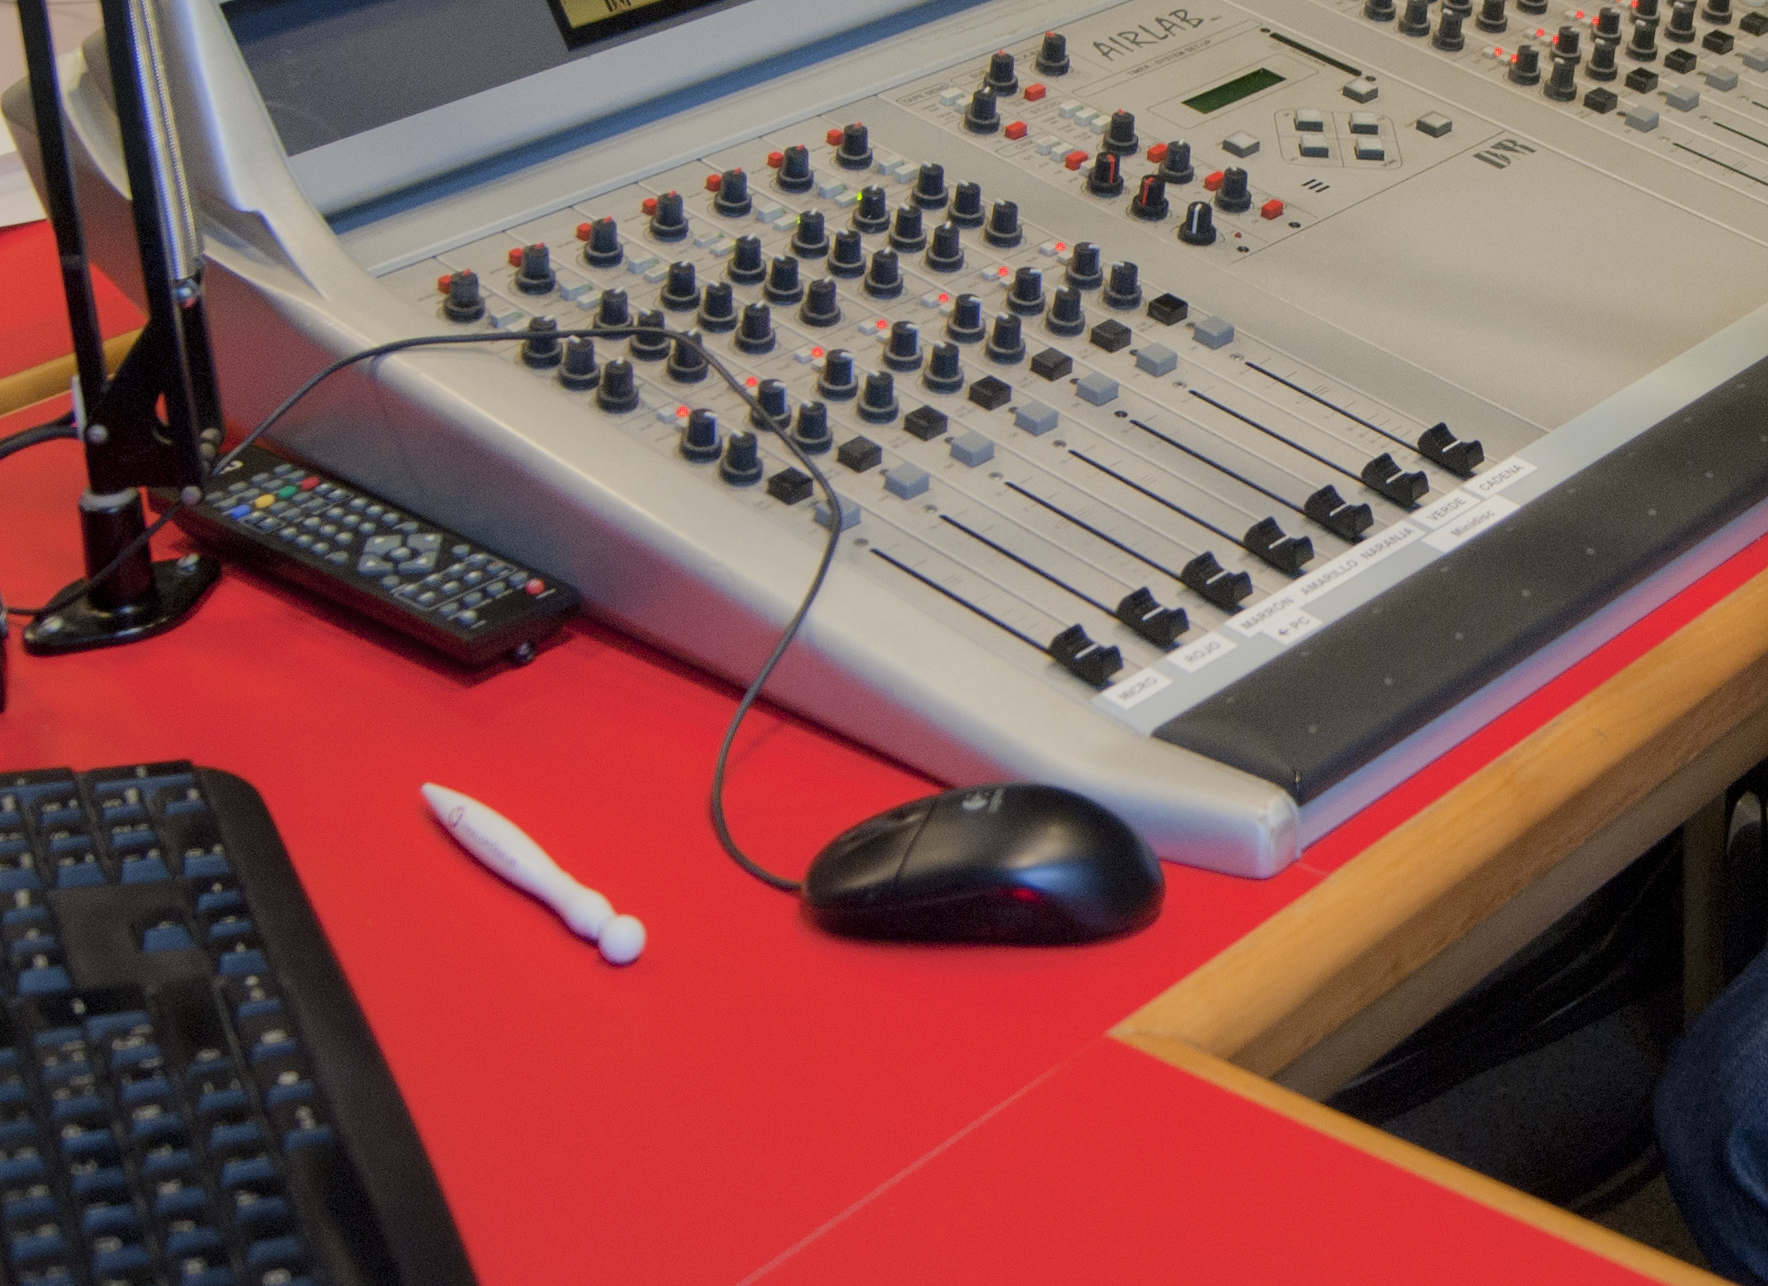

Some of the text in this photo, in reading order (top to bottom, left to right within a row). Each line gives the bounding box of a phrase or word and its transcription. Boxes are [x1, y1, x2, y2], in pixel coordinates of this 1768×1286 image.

[1092, 8, 1204, 62] AIRLAB
[1478, 463, 1525, 492] CADENA
[1426, 496, 1467, 522] VERDE
[1450, 509, 1496, 538] Minidisc
[1300, 559, 1359, 596] AMARILLO
[1359, 526, 1415, 561] NARANJA
[1291, 615, 1311, 630] PC
[1184, 640, 1221, 664] ROJO
